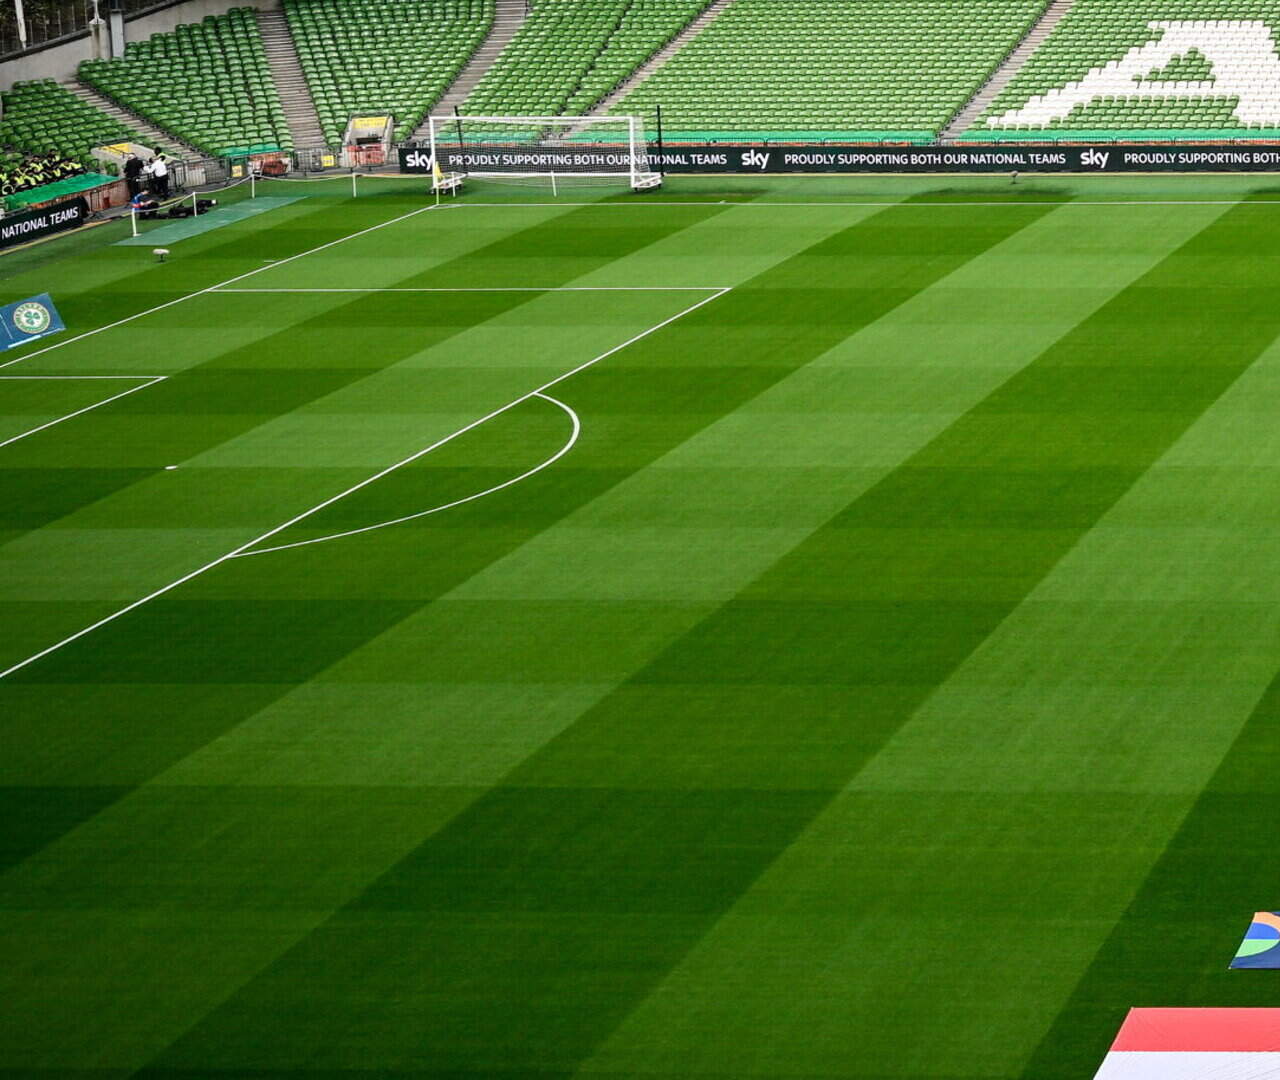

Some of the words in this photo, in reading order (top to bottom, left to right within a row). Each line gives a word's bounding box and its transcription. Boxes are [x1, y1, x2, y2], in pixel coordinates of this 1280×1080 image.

[406, 151, 434, 170] sky
[449, 155, 500, 165] PROUDLY
[503, 155, 571, 164] SUPPORTING
[574, 155, 604, 164] BOTH
[606, 154, 629, 165] OUR
[632, 154, 687, 165] NATIONAL
[690, 154, 727, 164] TEAMS
[742, 149, 769, 169] sky
[785, 154, 835, 164] PROUDLY
[838, 154, 908, 164] SUPPORTING
[911, 154, 941, 164] BOTH
[944, 154, 967, 164] OUR
[971, 154, 1026, 164] NATIONAL
[1029, 154, 1066, 163] TEAMS
[1081, 149, 1109, 168] sky
[1125, 153, 1176, 163] PROUDLY
[1179, 153, 1250, 163] SUPPORTING
[1, 217, 48, 240] NATIONAL
[50, 207, 78, 225] TEAMS
